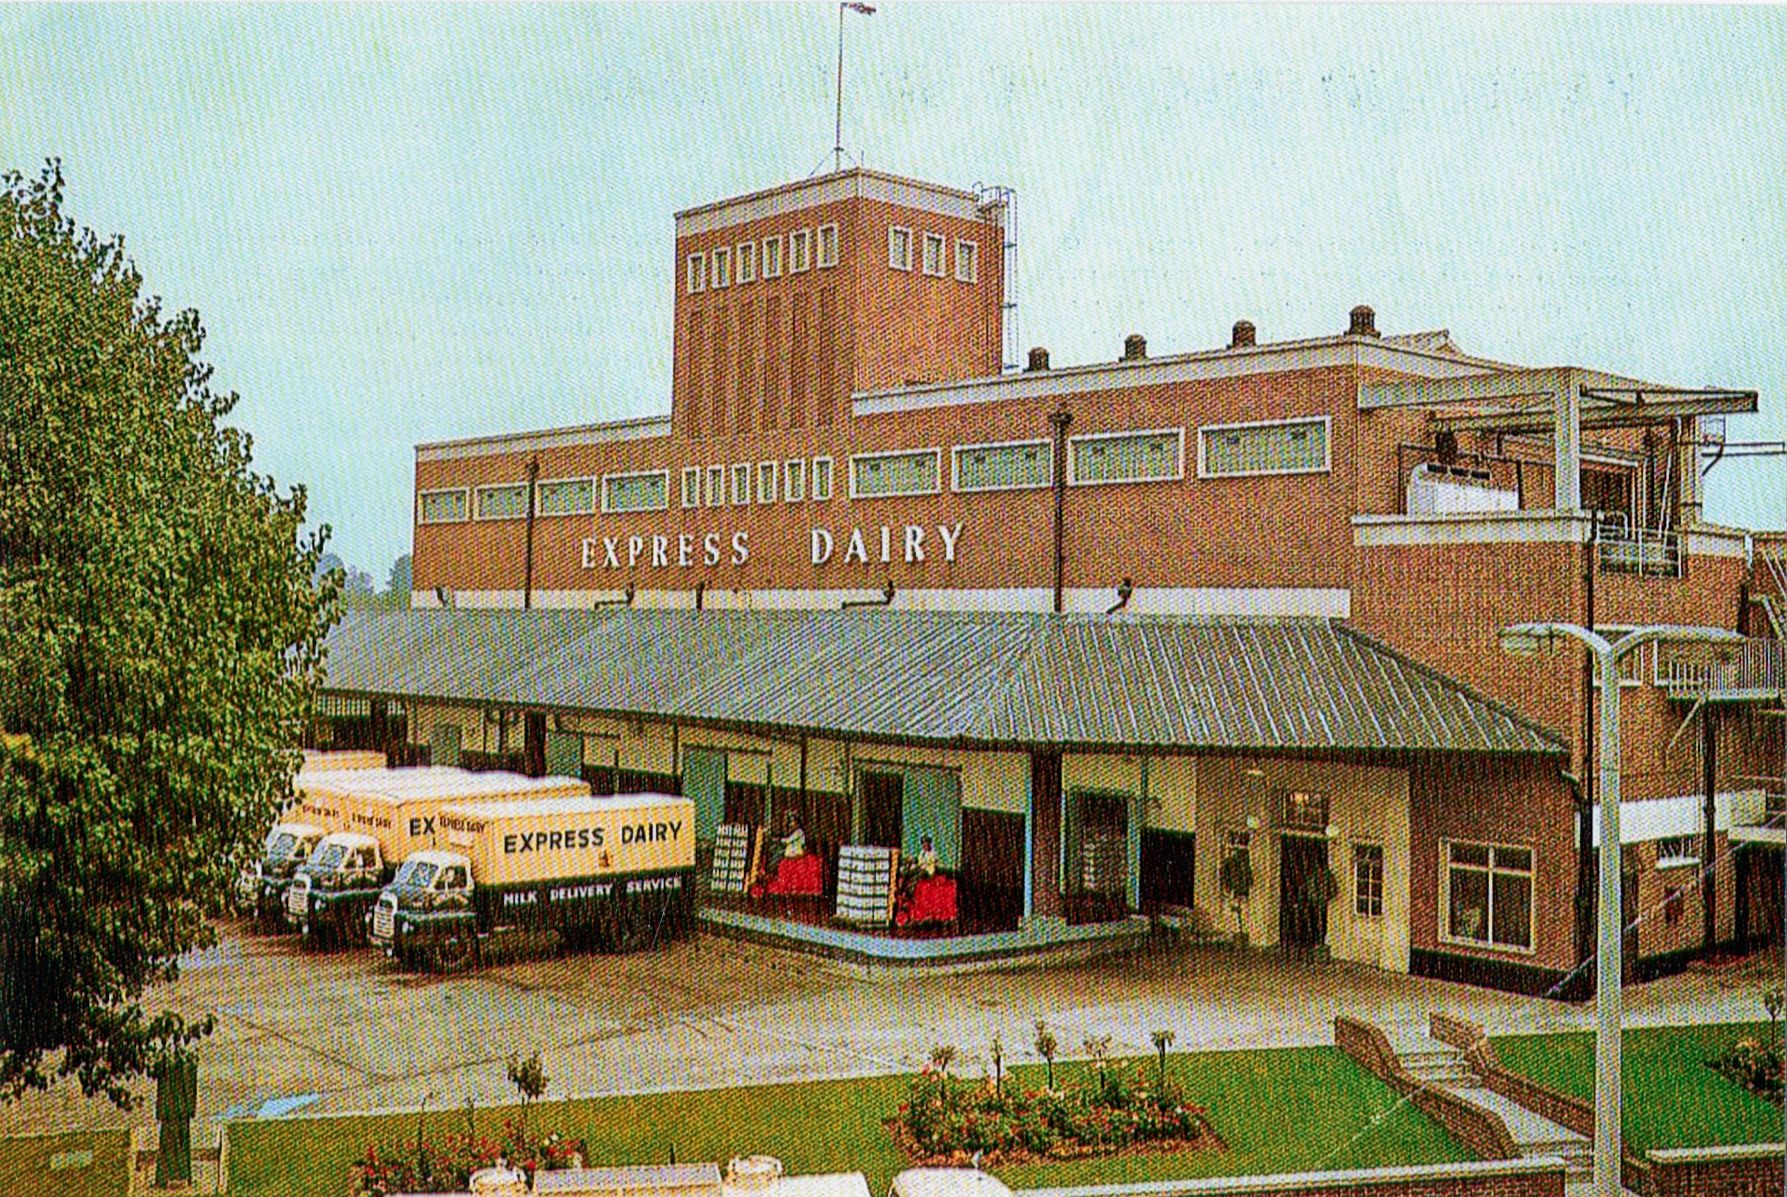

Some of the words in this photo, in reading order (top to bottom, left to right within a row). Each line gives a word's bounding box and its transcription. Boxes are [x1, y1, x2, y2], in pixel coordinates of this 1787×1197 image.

[581, 531, 749, 569] EXPRESS
[811, 522, 963, 565] DAIRY
[504, 826, 604, 853] EXPRESS
[621, 820, 682, 845] DAIRY
[503, 889, 538, 906] MILK
[550, 882, 613, 900] DELIVERY
[626, 876, 682, 894] SERVICE
